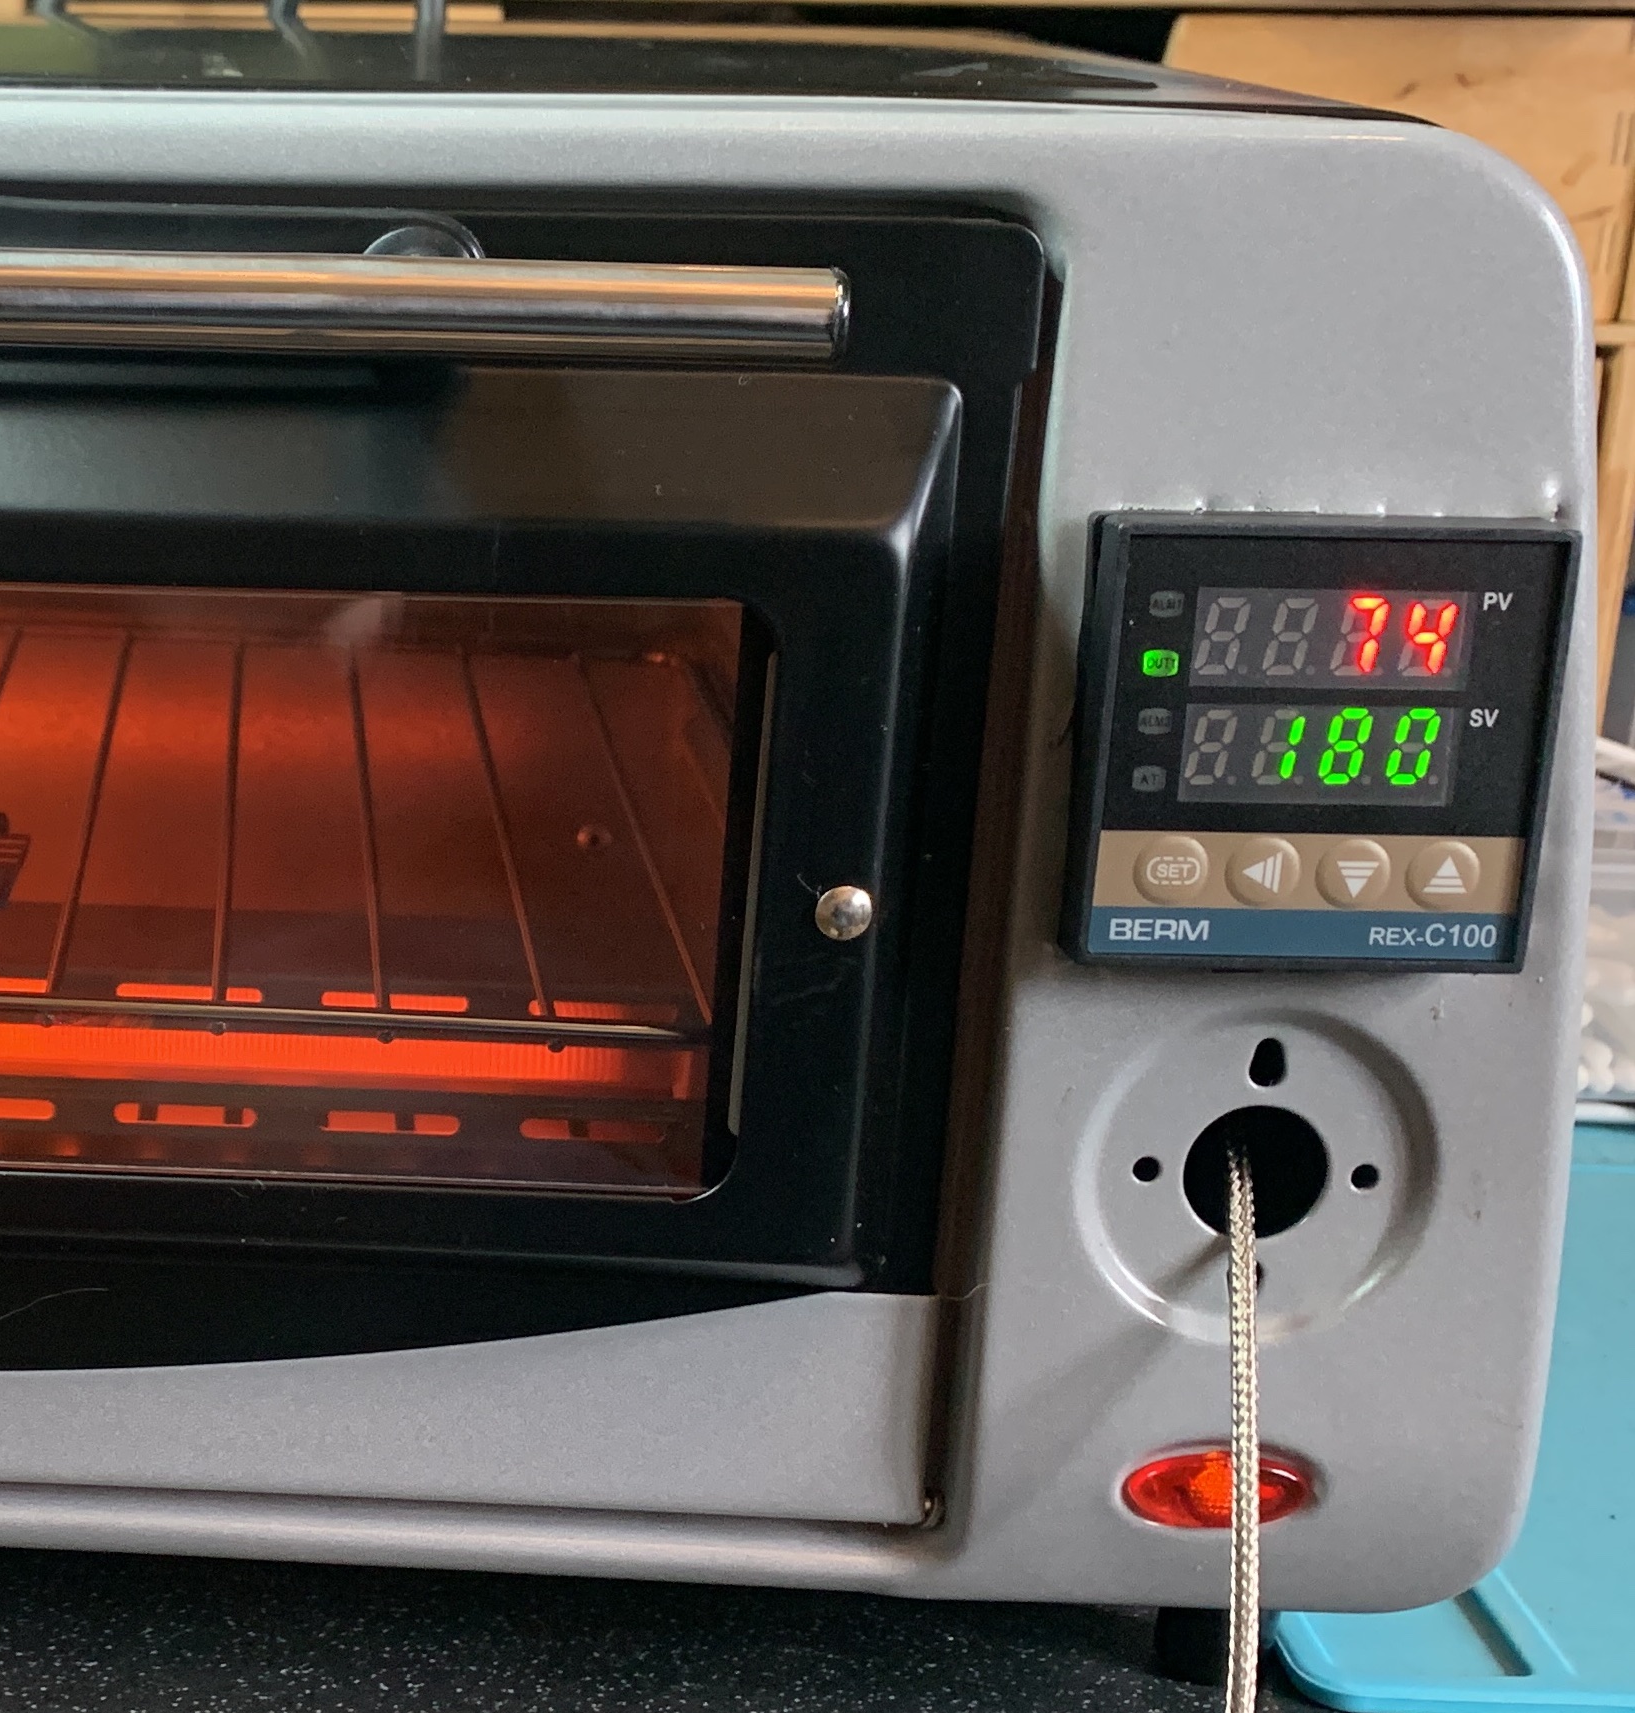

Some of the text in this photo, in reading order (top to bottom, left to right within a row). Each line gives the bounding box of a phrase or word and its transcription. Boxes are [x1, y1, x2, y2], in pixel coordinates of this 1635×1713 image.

[1482, 591, 1513, 612] PV
[1350, 596, 1459, 675] 74
[1469, 707, 1500, 728] SV
[1279, 707, 1442, 786] 180
[1139, 773, 1160, 785] AT
[1155, 862, 1193, 879] SET
[1108, 917, 1211, 942] BERM
[1368, 922, 1498, 948] REX-C100
